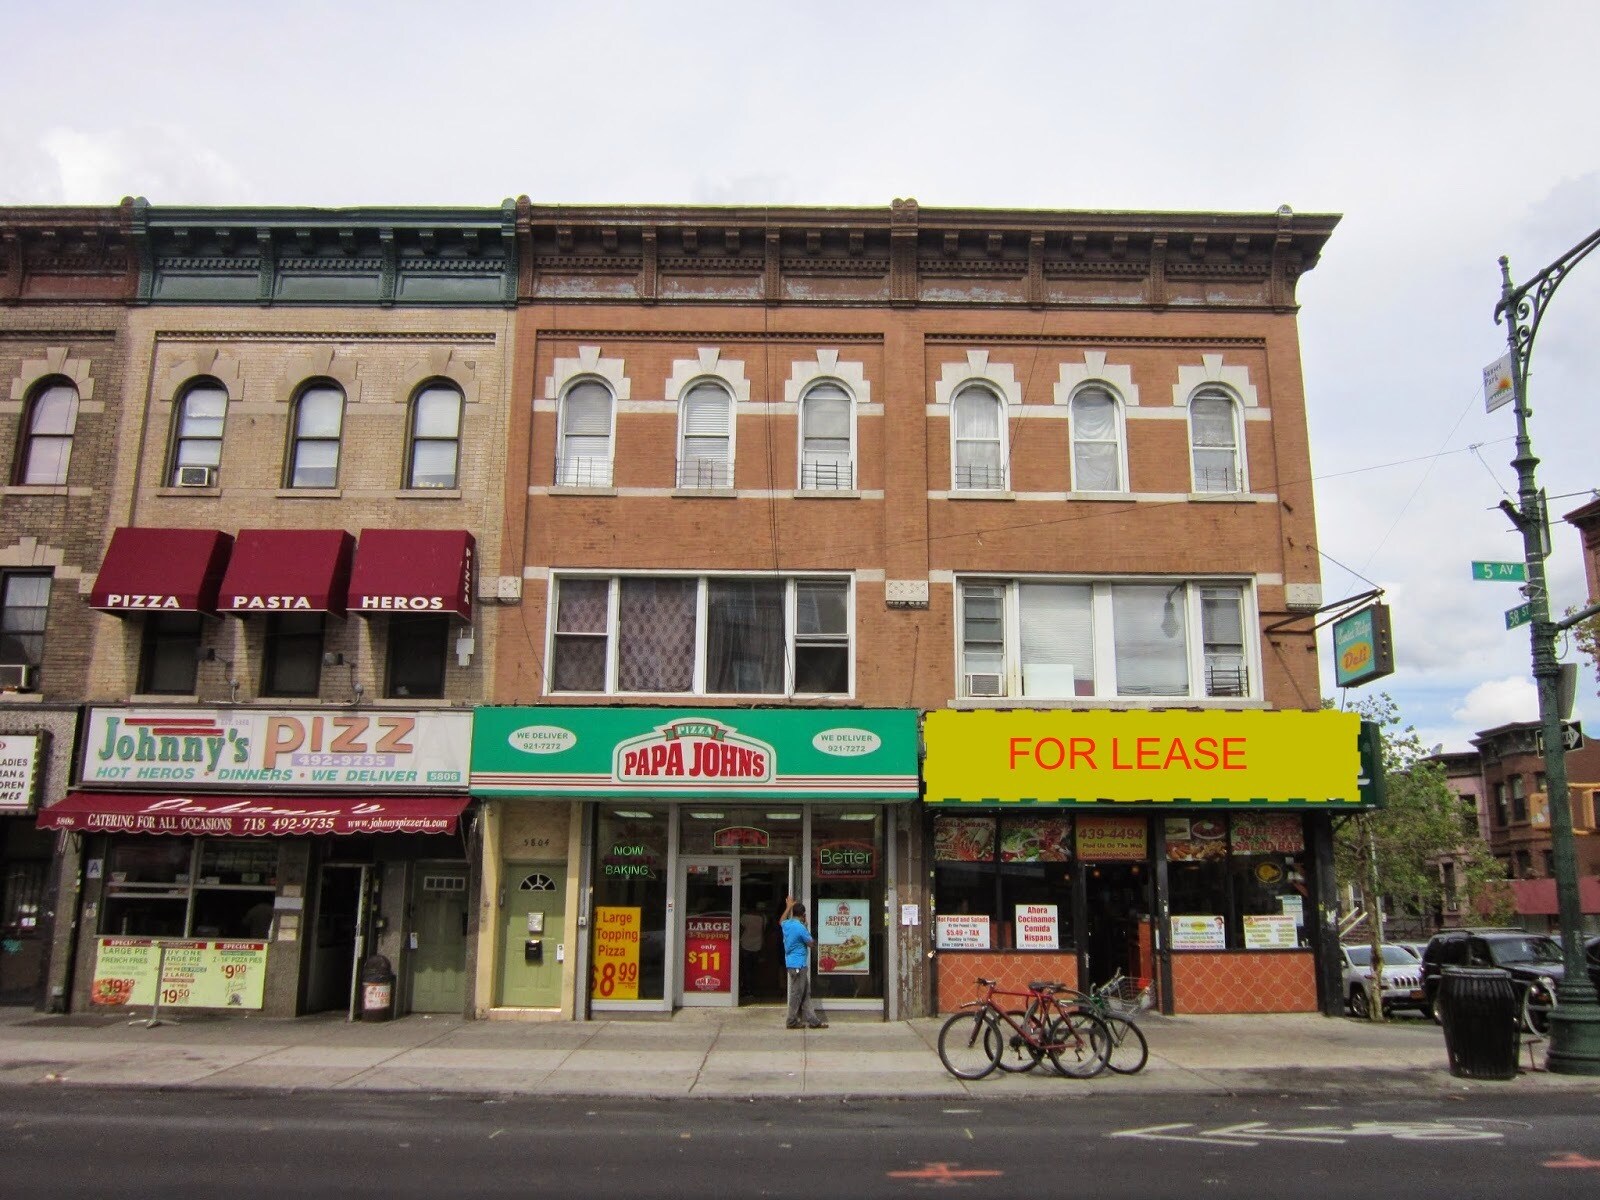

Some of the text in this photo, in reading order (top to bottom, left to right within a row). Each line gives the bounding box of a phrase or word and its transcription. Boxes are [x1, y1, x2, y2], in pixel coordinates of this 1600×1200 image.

[1484, 564, 1514, 579] 5 AV
[106, 594, 443, 609] PIZZA PASTA HEROS
[1509, 606, 1530, 627] 58 ST
[516, 732, 569, 740] WE DELIVER
[675, 724, 714, 737] PIZZA
[98, 716, 250, 771] Johnny's
[820, 734, 874, 742] WE DELIVER
[827, 745, 866, 753] 921-7272
[298, 755, 387, 767] 492-9735
[623, 741, 765, 778] PAPA JOHN'S
[18, 770, 25, 778] &
[95, 766, 418, 782] HOT HEROS DINNERS WE DELIVER
[430, 772, 459, 781] 5806
[56, 814, 448, 831] 5806 CATERING FOR ALL OCCASIONS 718 492-9735 www.johnnyspizzeria.com
[524, 839, 551, 847] 5804
[613, 845, 644, 857] NOW
[820, 848, 873, 865] Better
[90, 863, 99, 873] A
[604, 864, 649, 876] BAKING
[1027, 906, 1049, 914] Ahora
[602, 911, 633, 927] Large
[1017, 915, 1056, 924] Cocinamos
[688, 922, 731, 931] LARGE
[1024, 924, 1051, 933] Comida
[1024, 934, 1053, 943] Hispana
[134, 948, 148, 956] PIE
[597, 944, 626, 957] Pizza
[700, 944, 717, 952] only
[688, 950, 721, 971] $11
